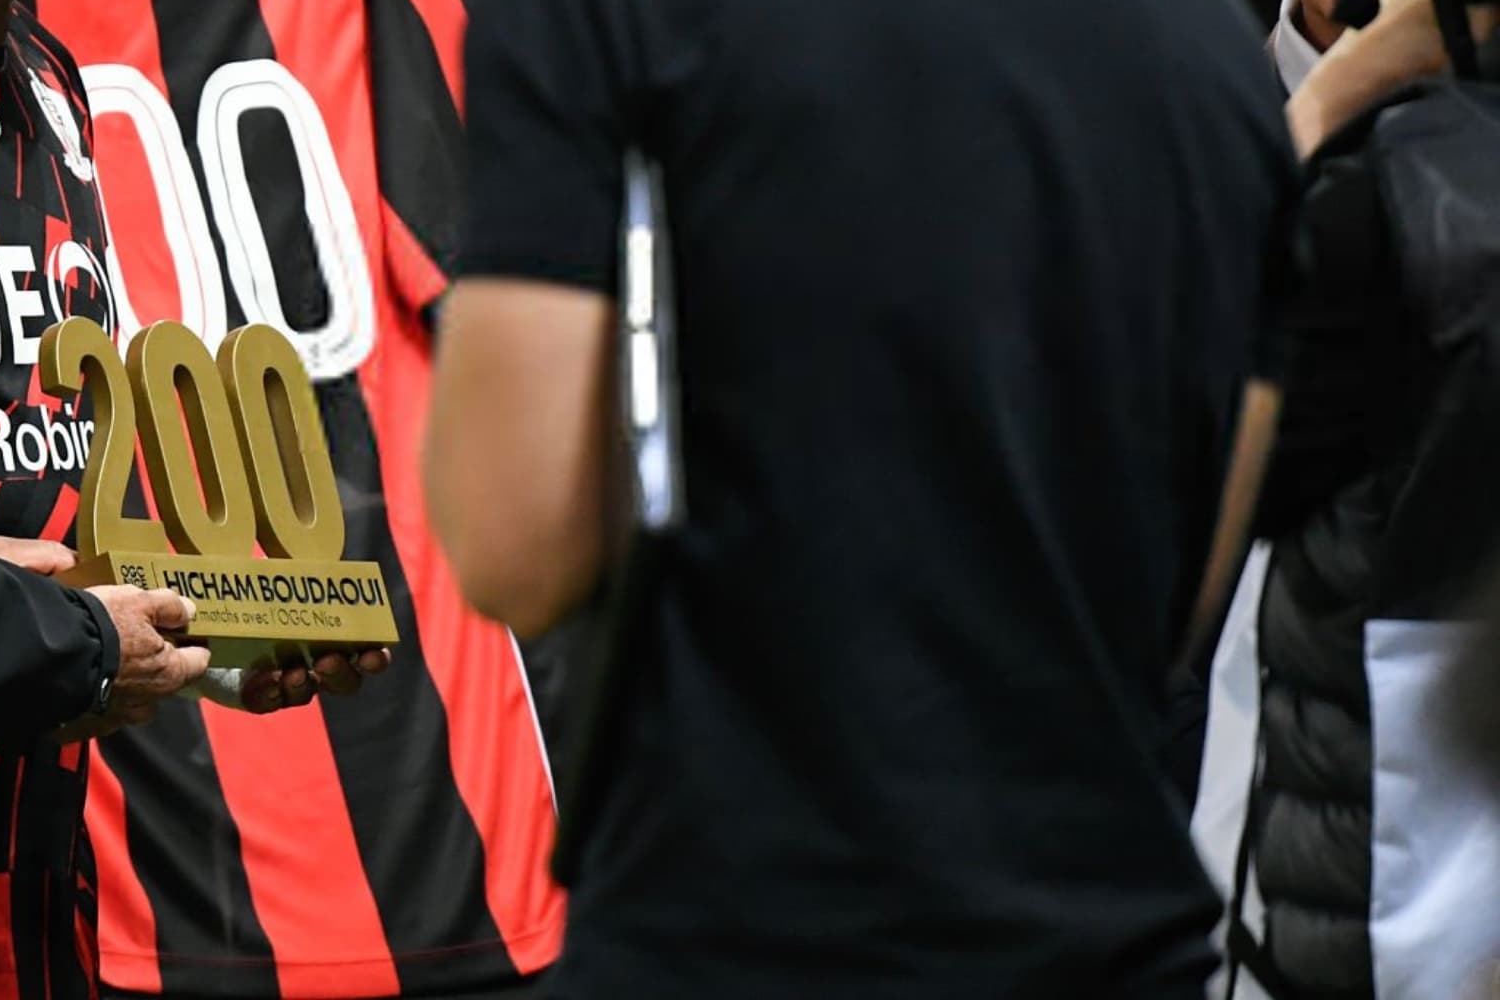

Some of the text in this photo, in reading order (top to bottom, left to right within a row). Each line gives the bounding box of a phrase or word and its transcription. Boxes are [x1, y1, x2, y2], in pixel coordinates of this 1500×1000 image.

[39, 316, 345, 562] 200
[120, 564, 146, 579] OGC
[163, 569, 384, 606] HICHAM BOUDAOUI
[199, 604, 239, 624] matchs
[242, 611, 269, 625] avec
[312, 609, 342, 628] Nice
